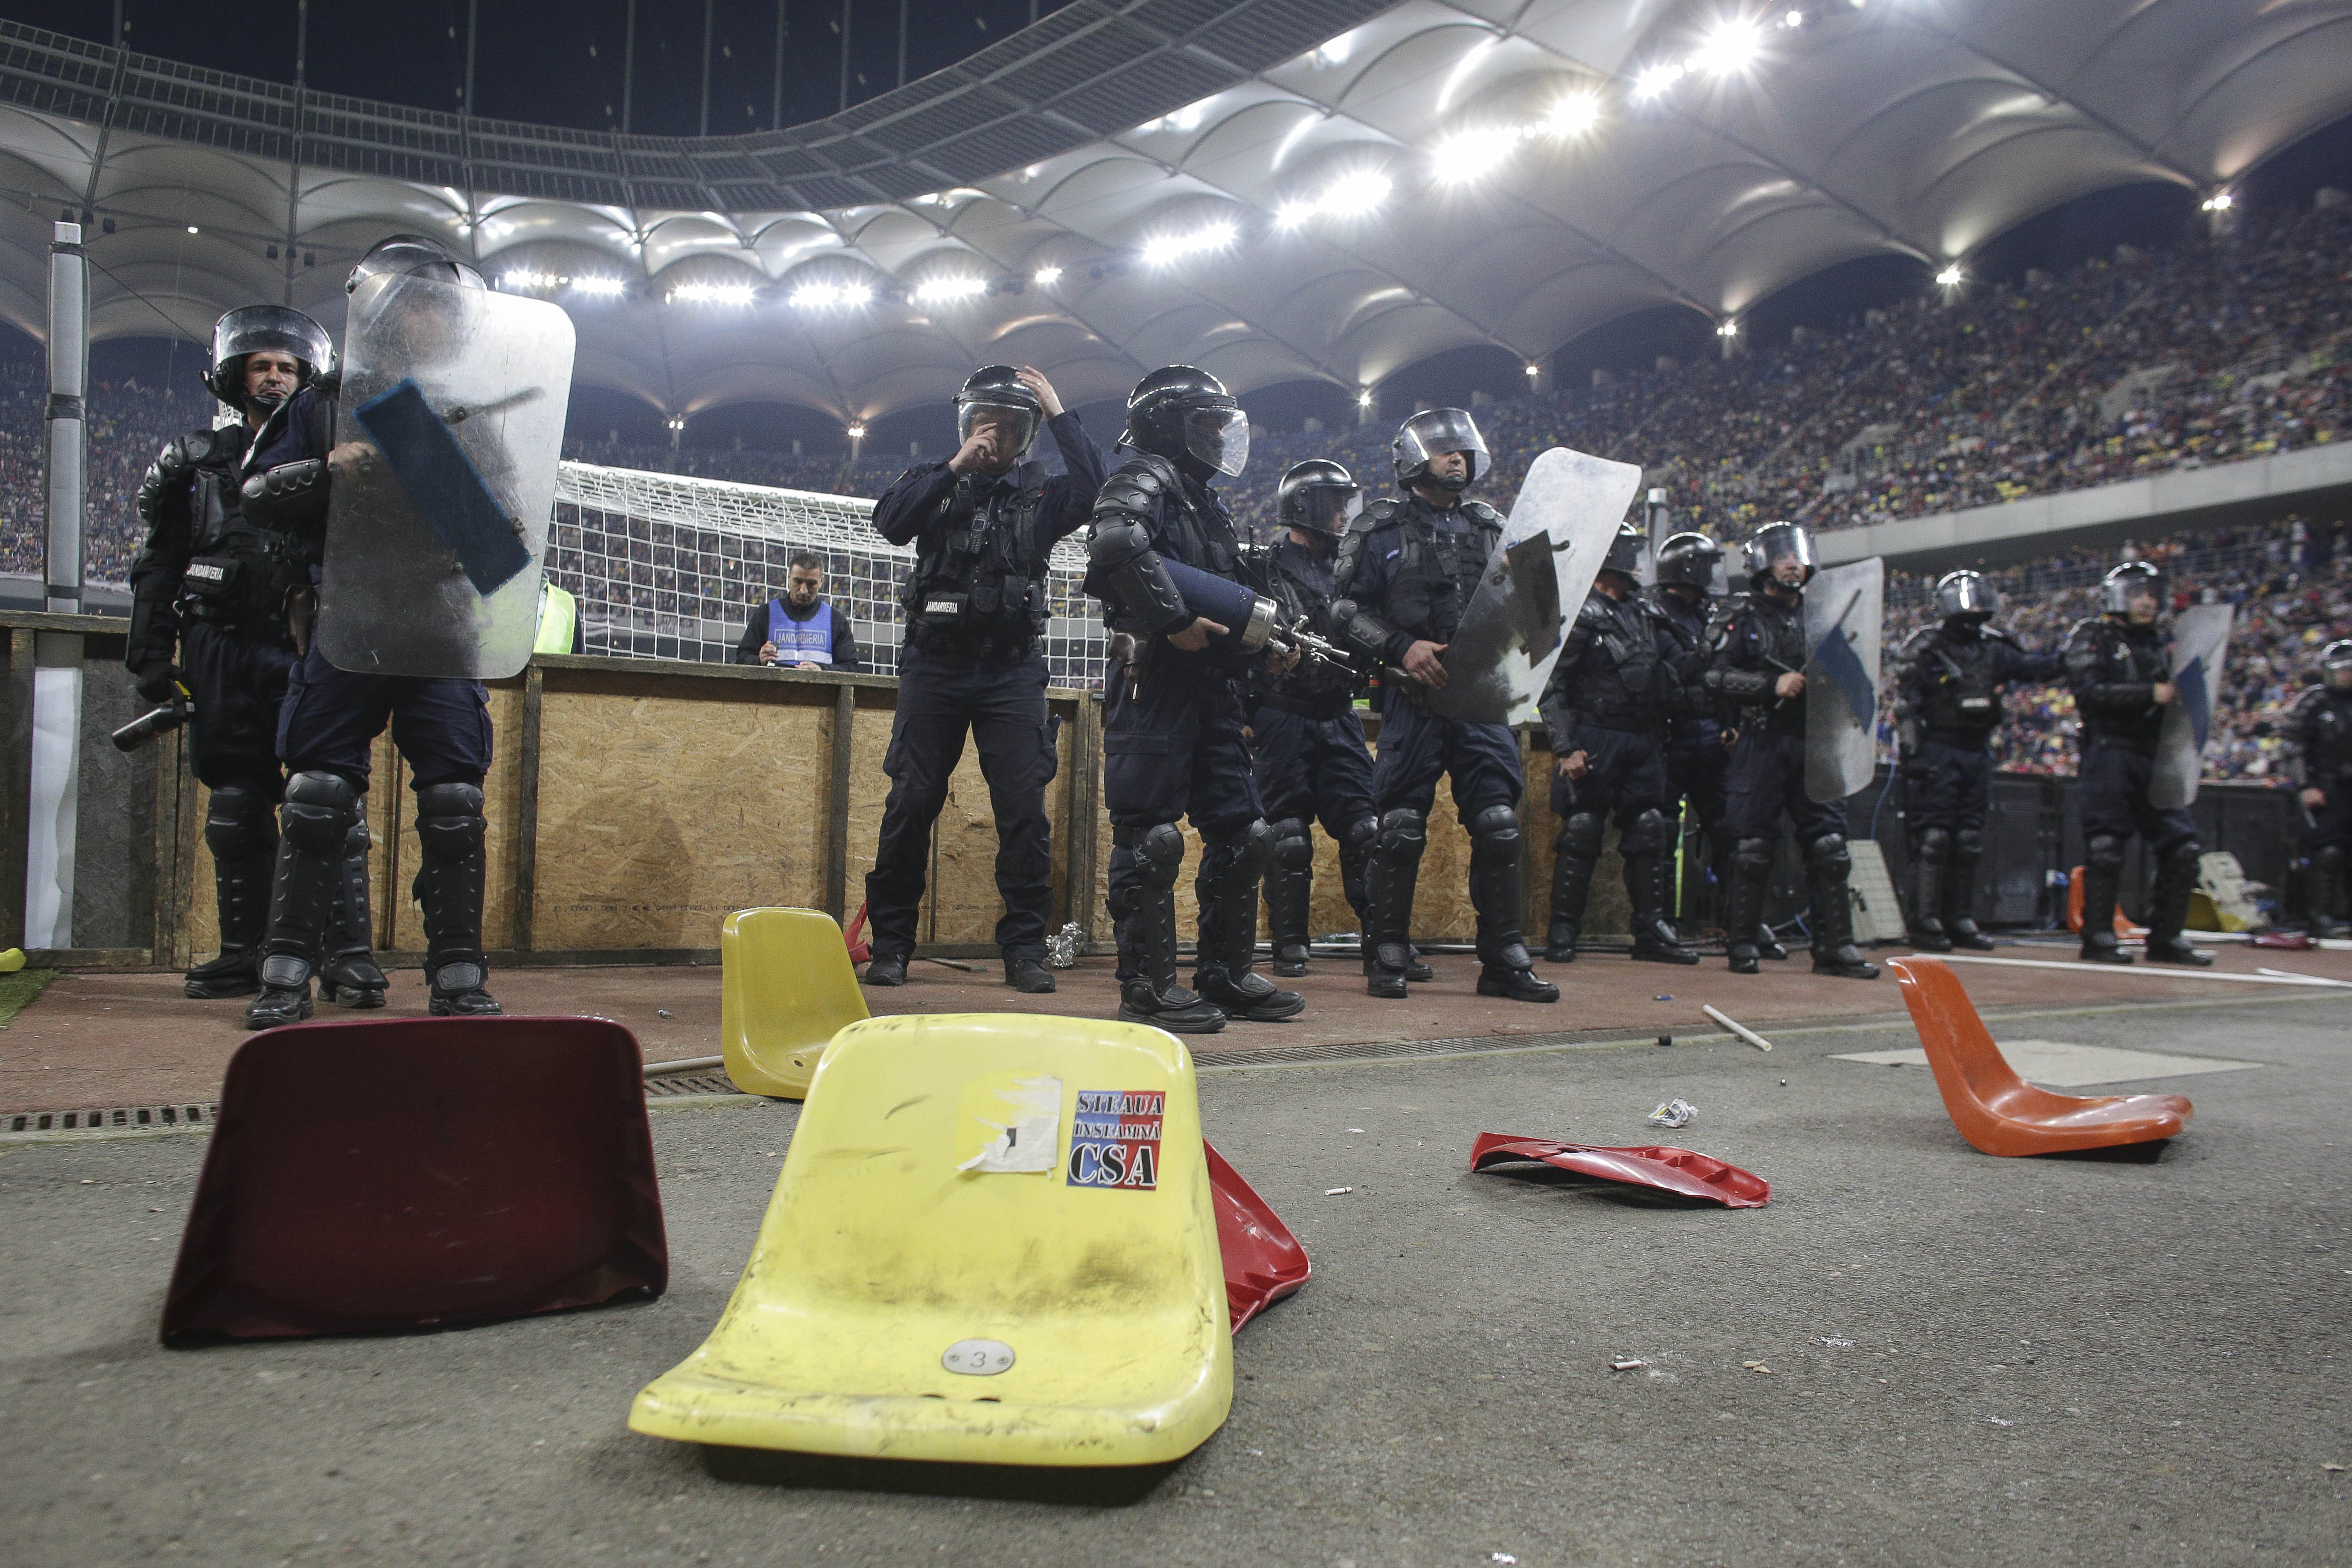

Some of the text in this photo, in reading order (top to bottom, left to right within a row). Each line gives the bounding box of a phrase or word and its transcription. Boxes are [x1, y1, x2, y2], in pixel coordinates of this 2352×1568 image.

[925, 601, 958, 614] JANDARMERIA
[1076, 1093, 1164, 1116] STEAUA
[1068, 1142, 1157, 1186] CSA
[970, 1351, 986, 1367] 3
